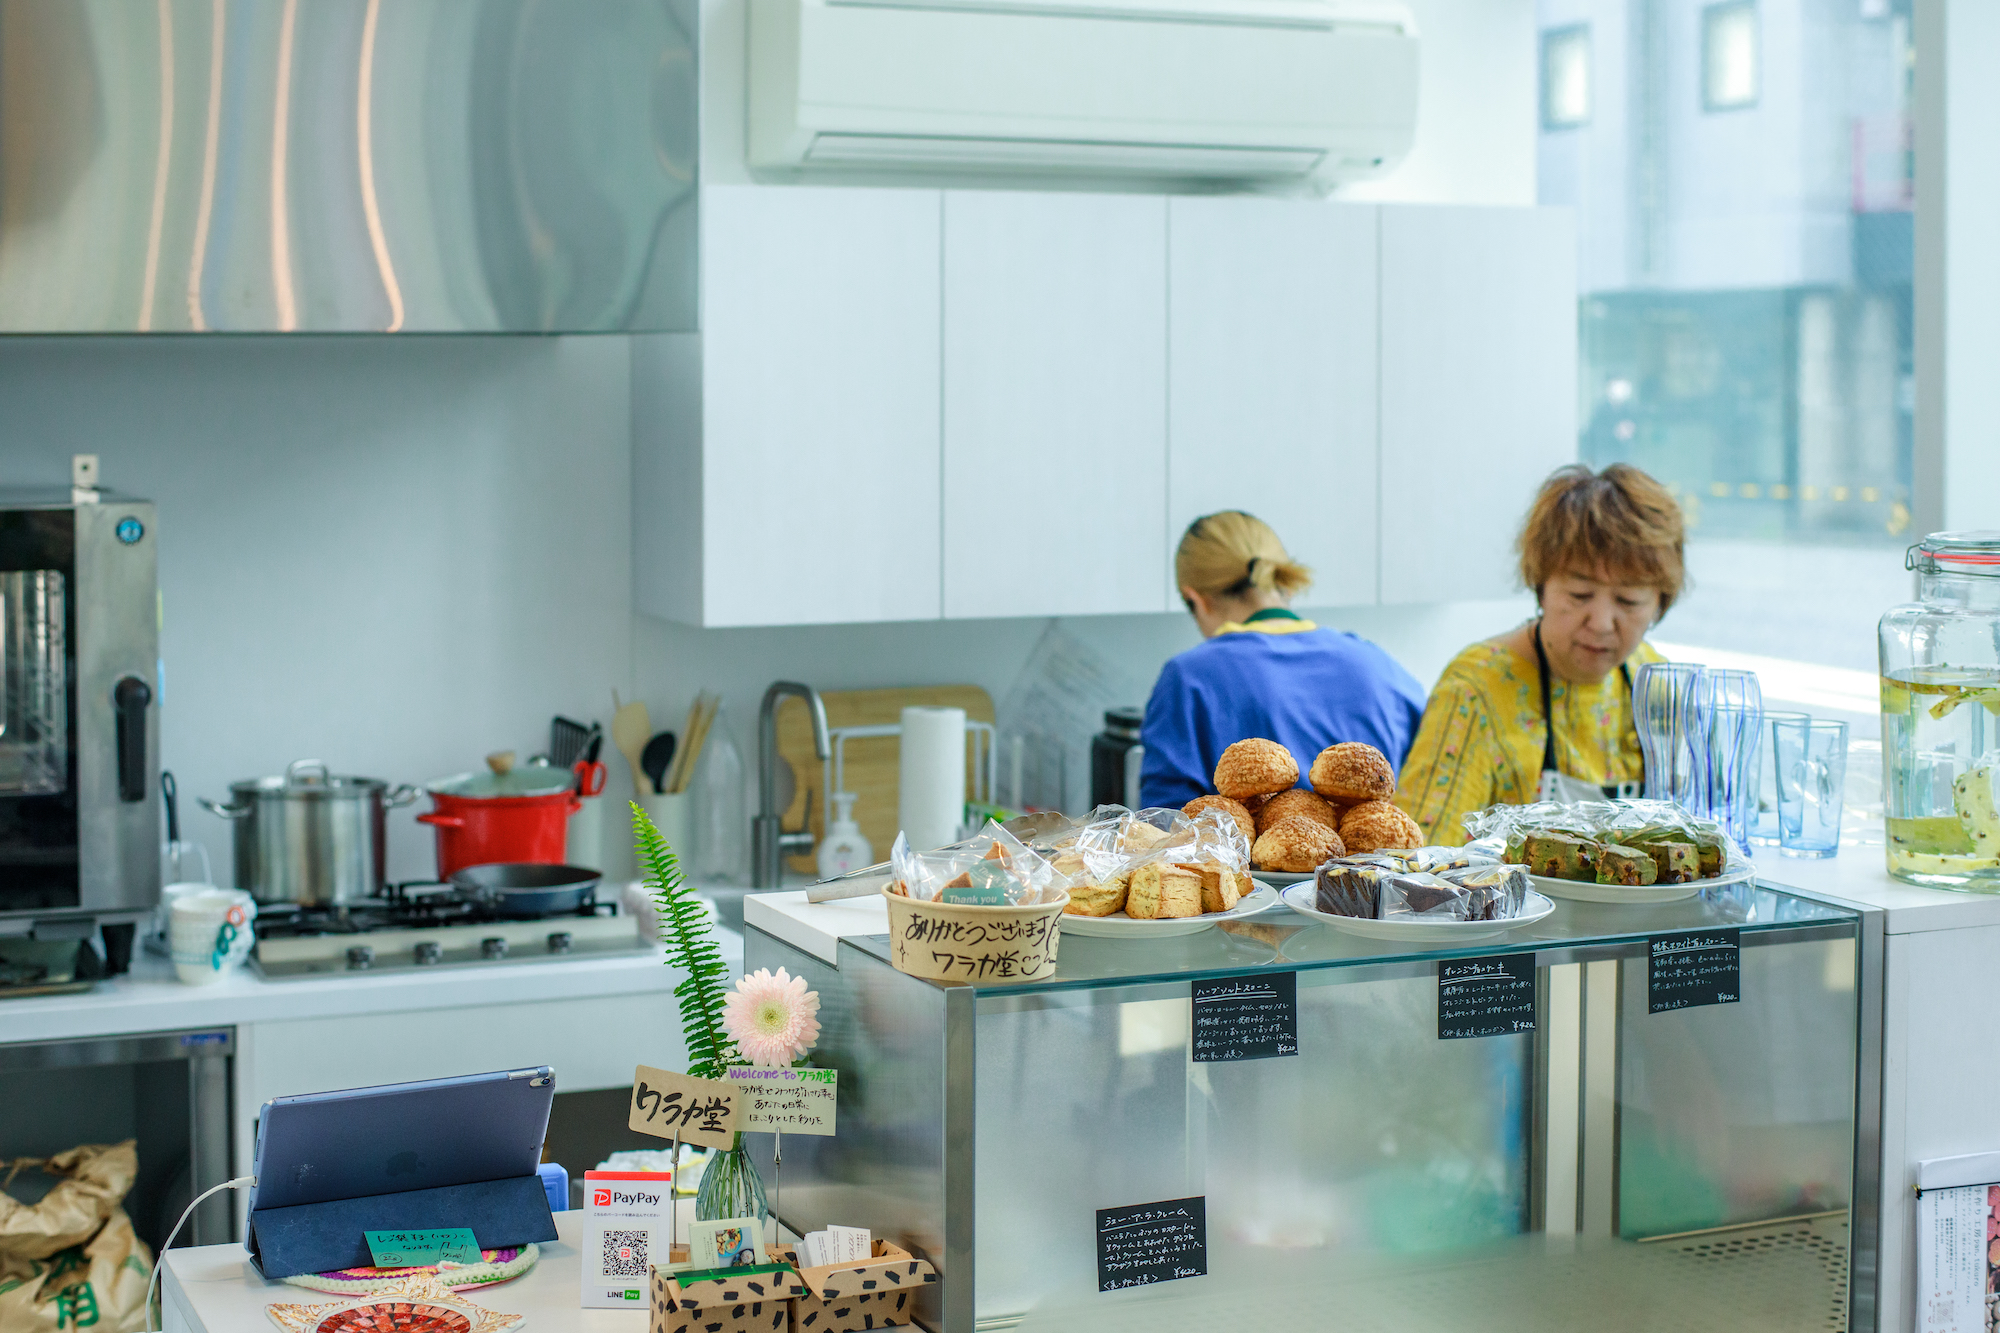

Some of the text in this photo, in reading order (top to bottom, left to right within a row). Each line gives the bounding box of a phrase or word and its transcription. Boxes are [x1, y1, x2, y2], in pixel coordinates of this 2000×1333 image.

[949, 895, 998, 905] Thank you
[905, 913, 1051, 946] ありがとうございます
[932, 950, 1020, 978] ワラカ堂
[729, 1068, 836, 1084] Welcome to ワラカ堂
[636, 1081, 732, 1134] ワラカ堂
[754, 1099, 811, 1111] あなたの日常に
[614, 1192, 661, 1206] PayPay
[626, 1291, 638, 1299] Pay
